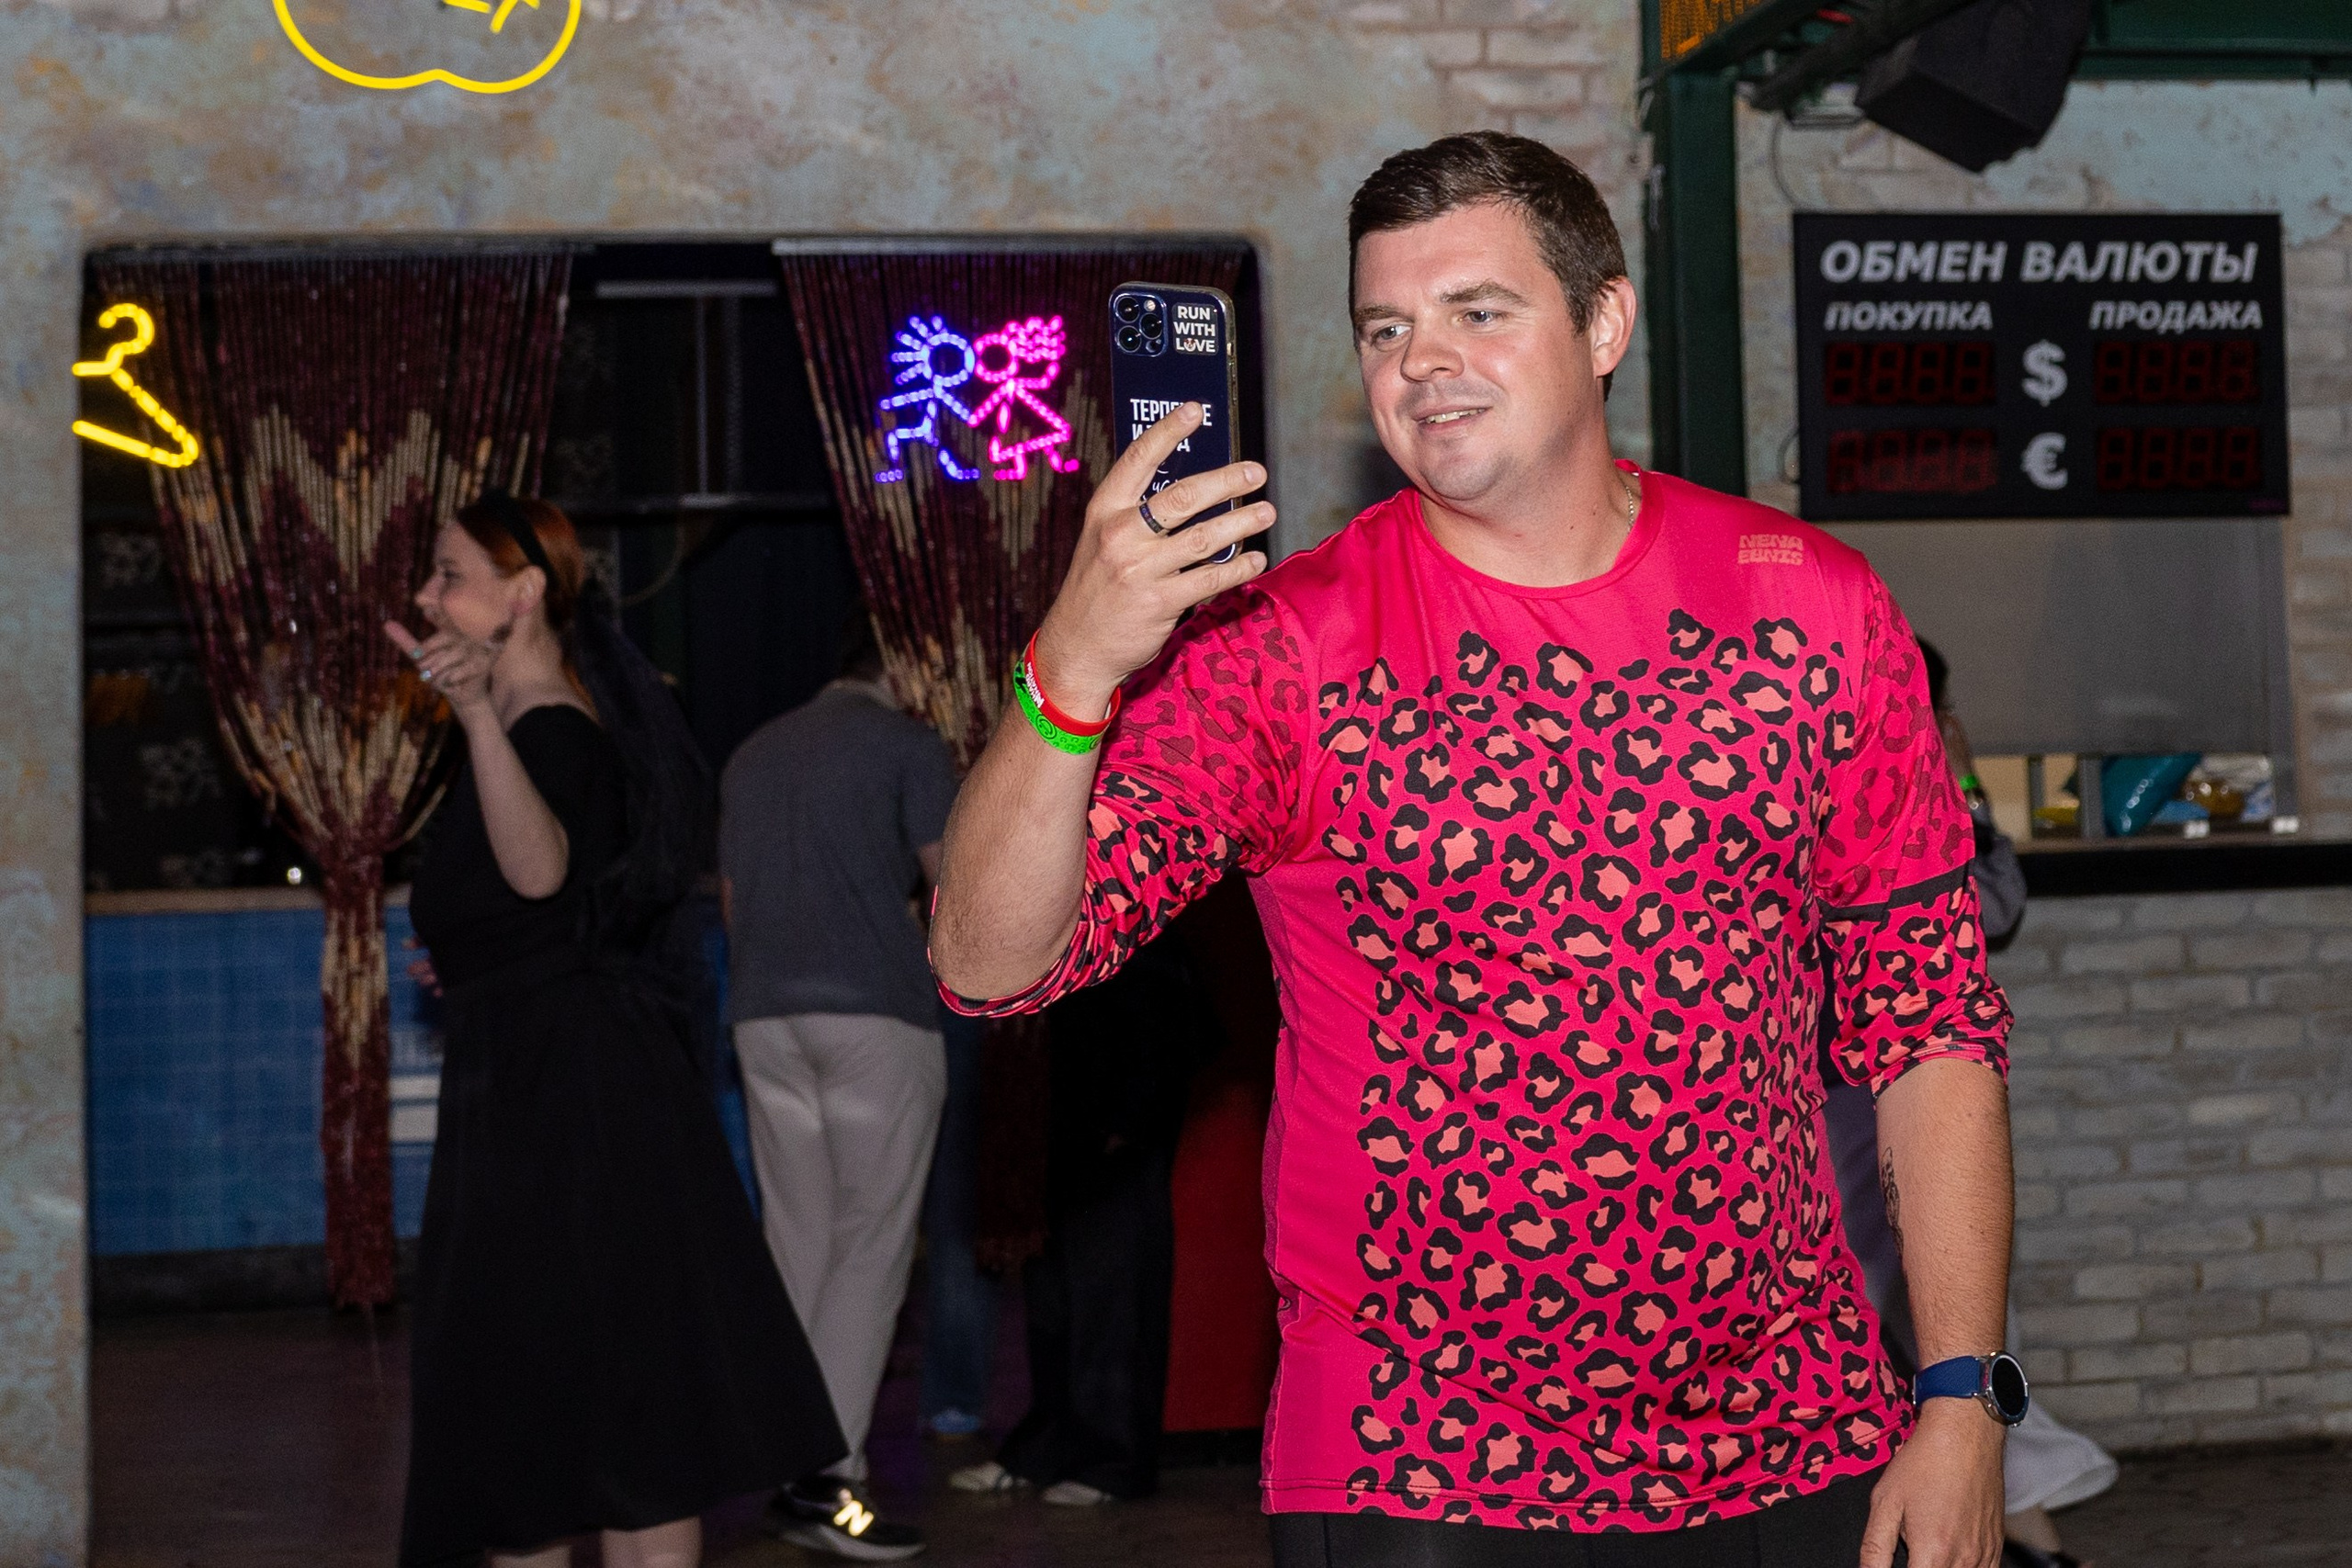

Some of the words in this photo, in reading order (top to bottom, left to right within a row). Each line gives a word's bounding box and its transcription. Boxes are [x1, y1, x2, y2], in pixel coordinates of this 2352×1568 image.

[1820, 240, 2008, 282] ОБМЕН
[2021, 241, 2259, 282] ВАЛЮТЫ
[1173, 321, 1216, 336] WITH
[1177, 305, 1211, 320] RUN
[1823, 300, 1994, 331] ПОКУПКА
[2088, 300, 2263, 334] ПРОДАЖА
[2022, 339, 2069, 406] $
[1130, 399, 1213, 426] ТЕРПЕ
[2021, 432, 2069, 491] €
[833, 1499, 875, 1537] N
